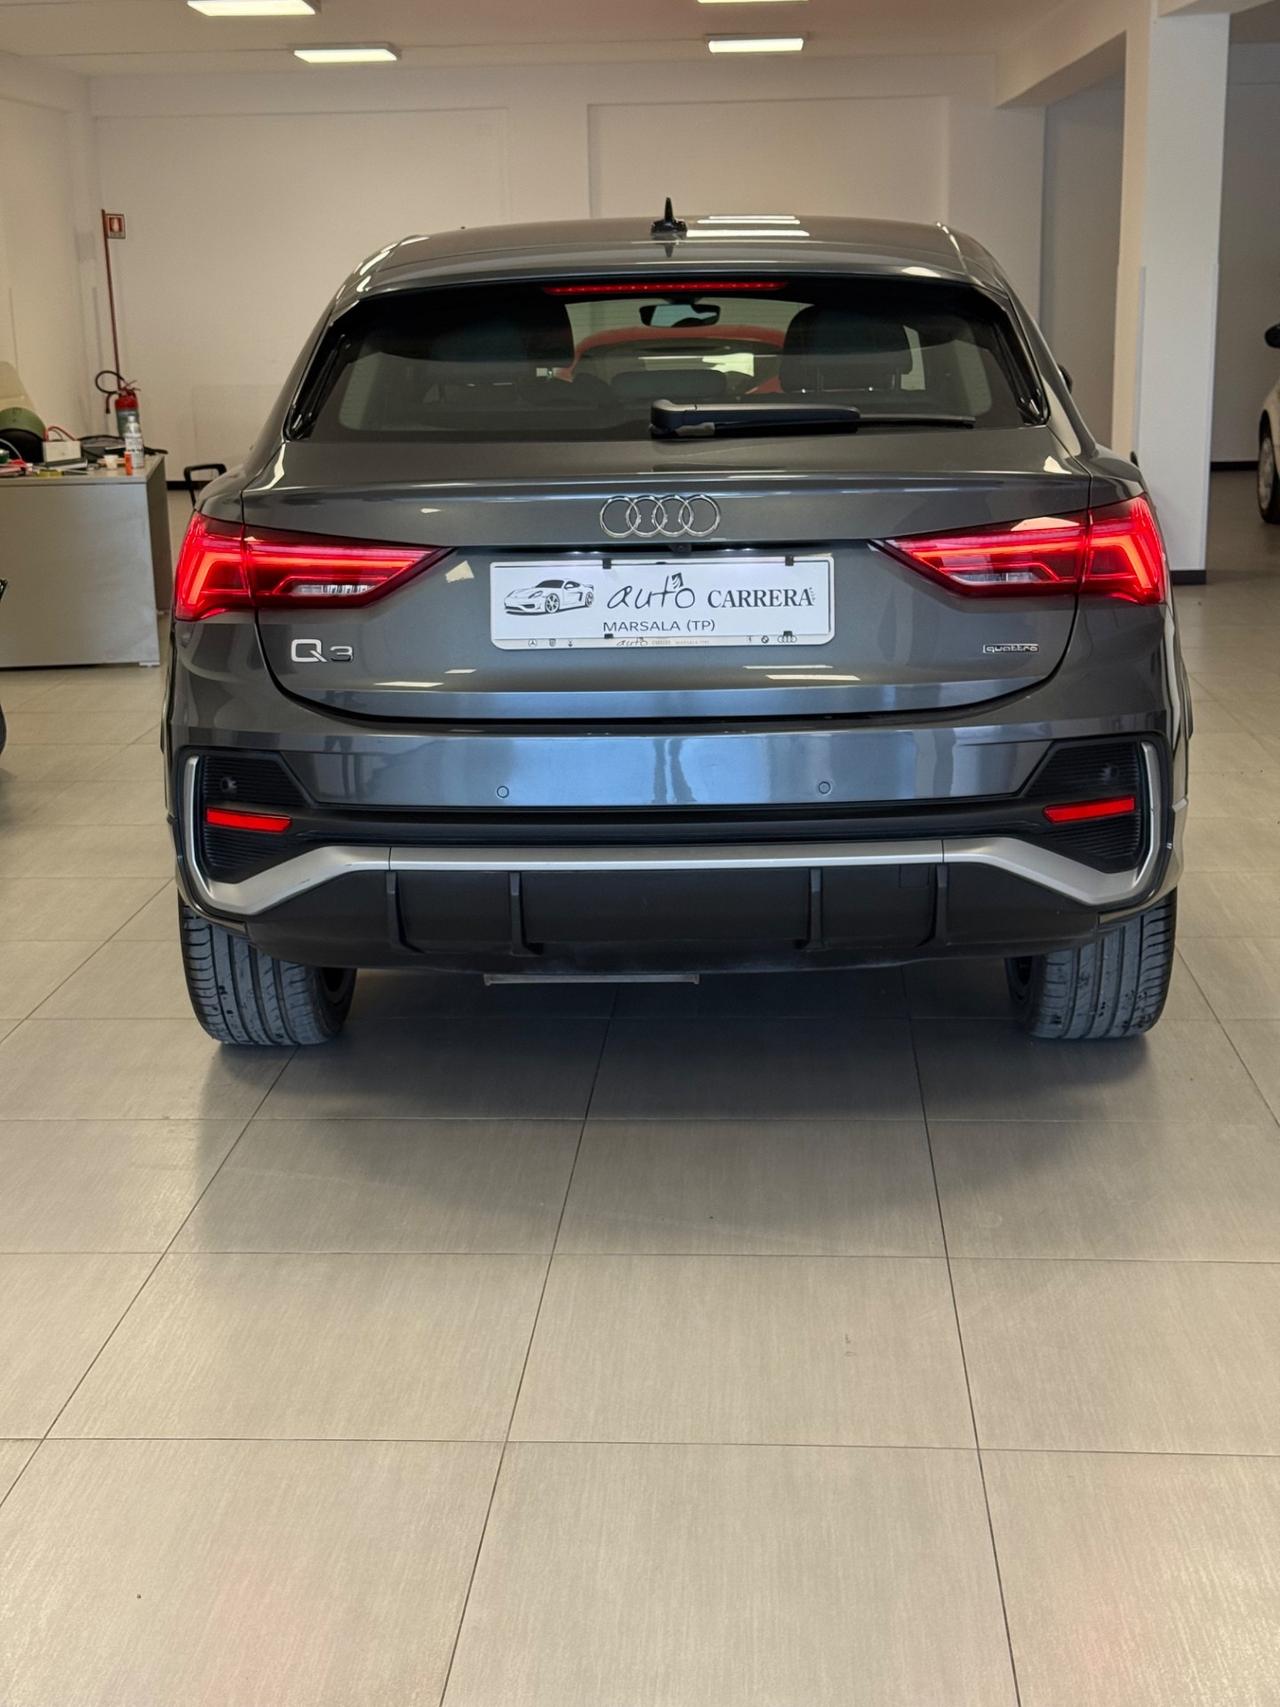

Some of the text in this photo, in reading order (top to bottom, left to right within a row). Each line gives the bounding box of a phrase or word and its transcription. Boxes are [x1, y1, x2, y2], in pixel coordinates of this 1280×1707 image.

[606, 573, 696, 610] auto
[707, 587, 813, 609] CARRERA
[603, 619, 715, 633] MARSALA (TP)
[290, 638, 354, 663] Q3
[983, 643, 1039, 654] quattro
